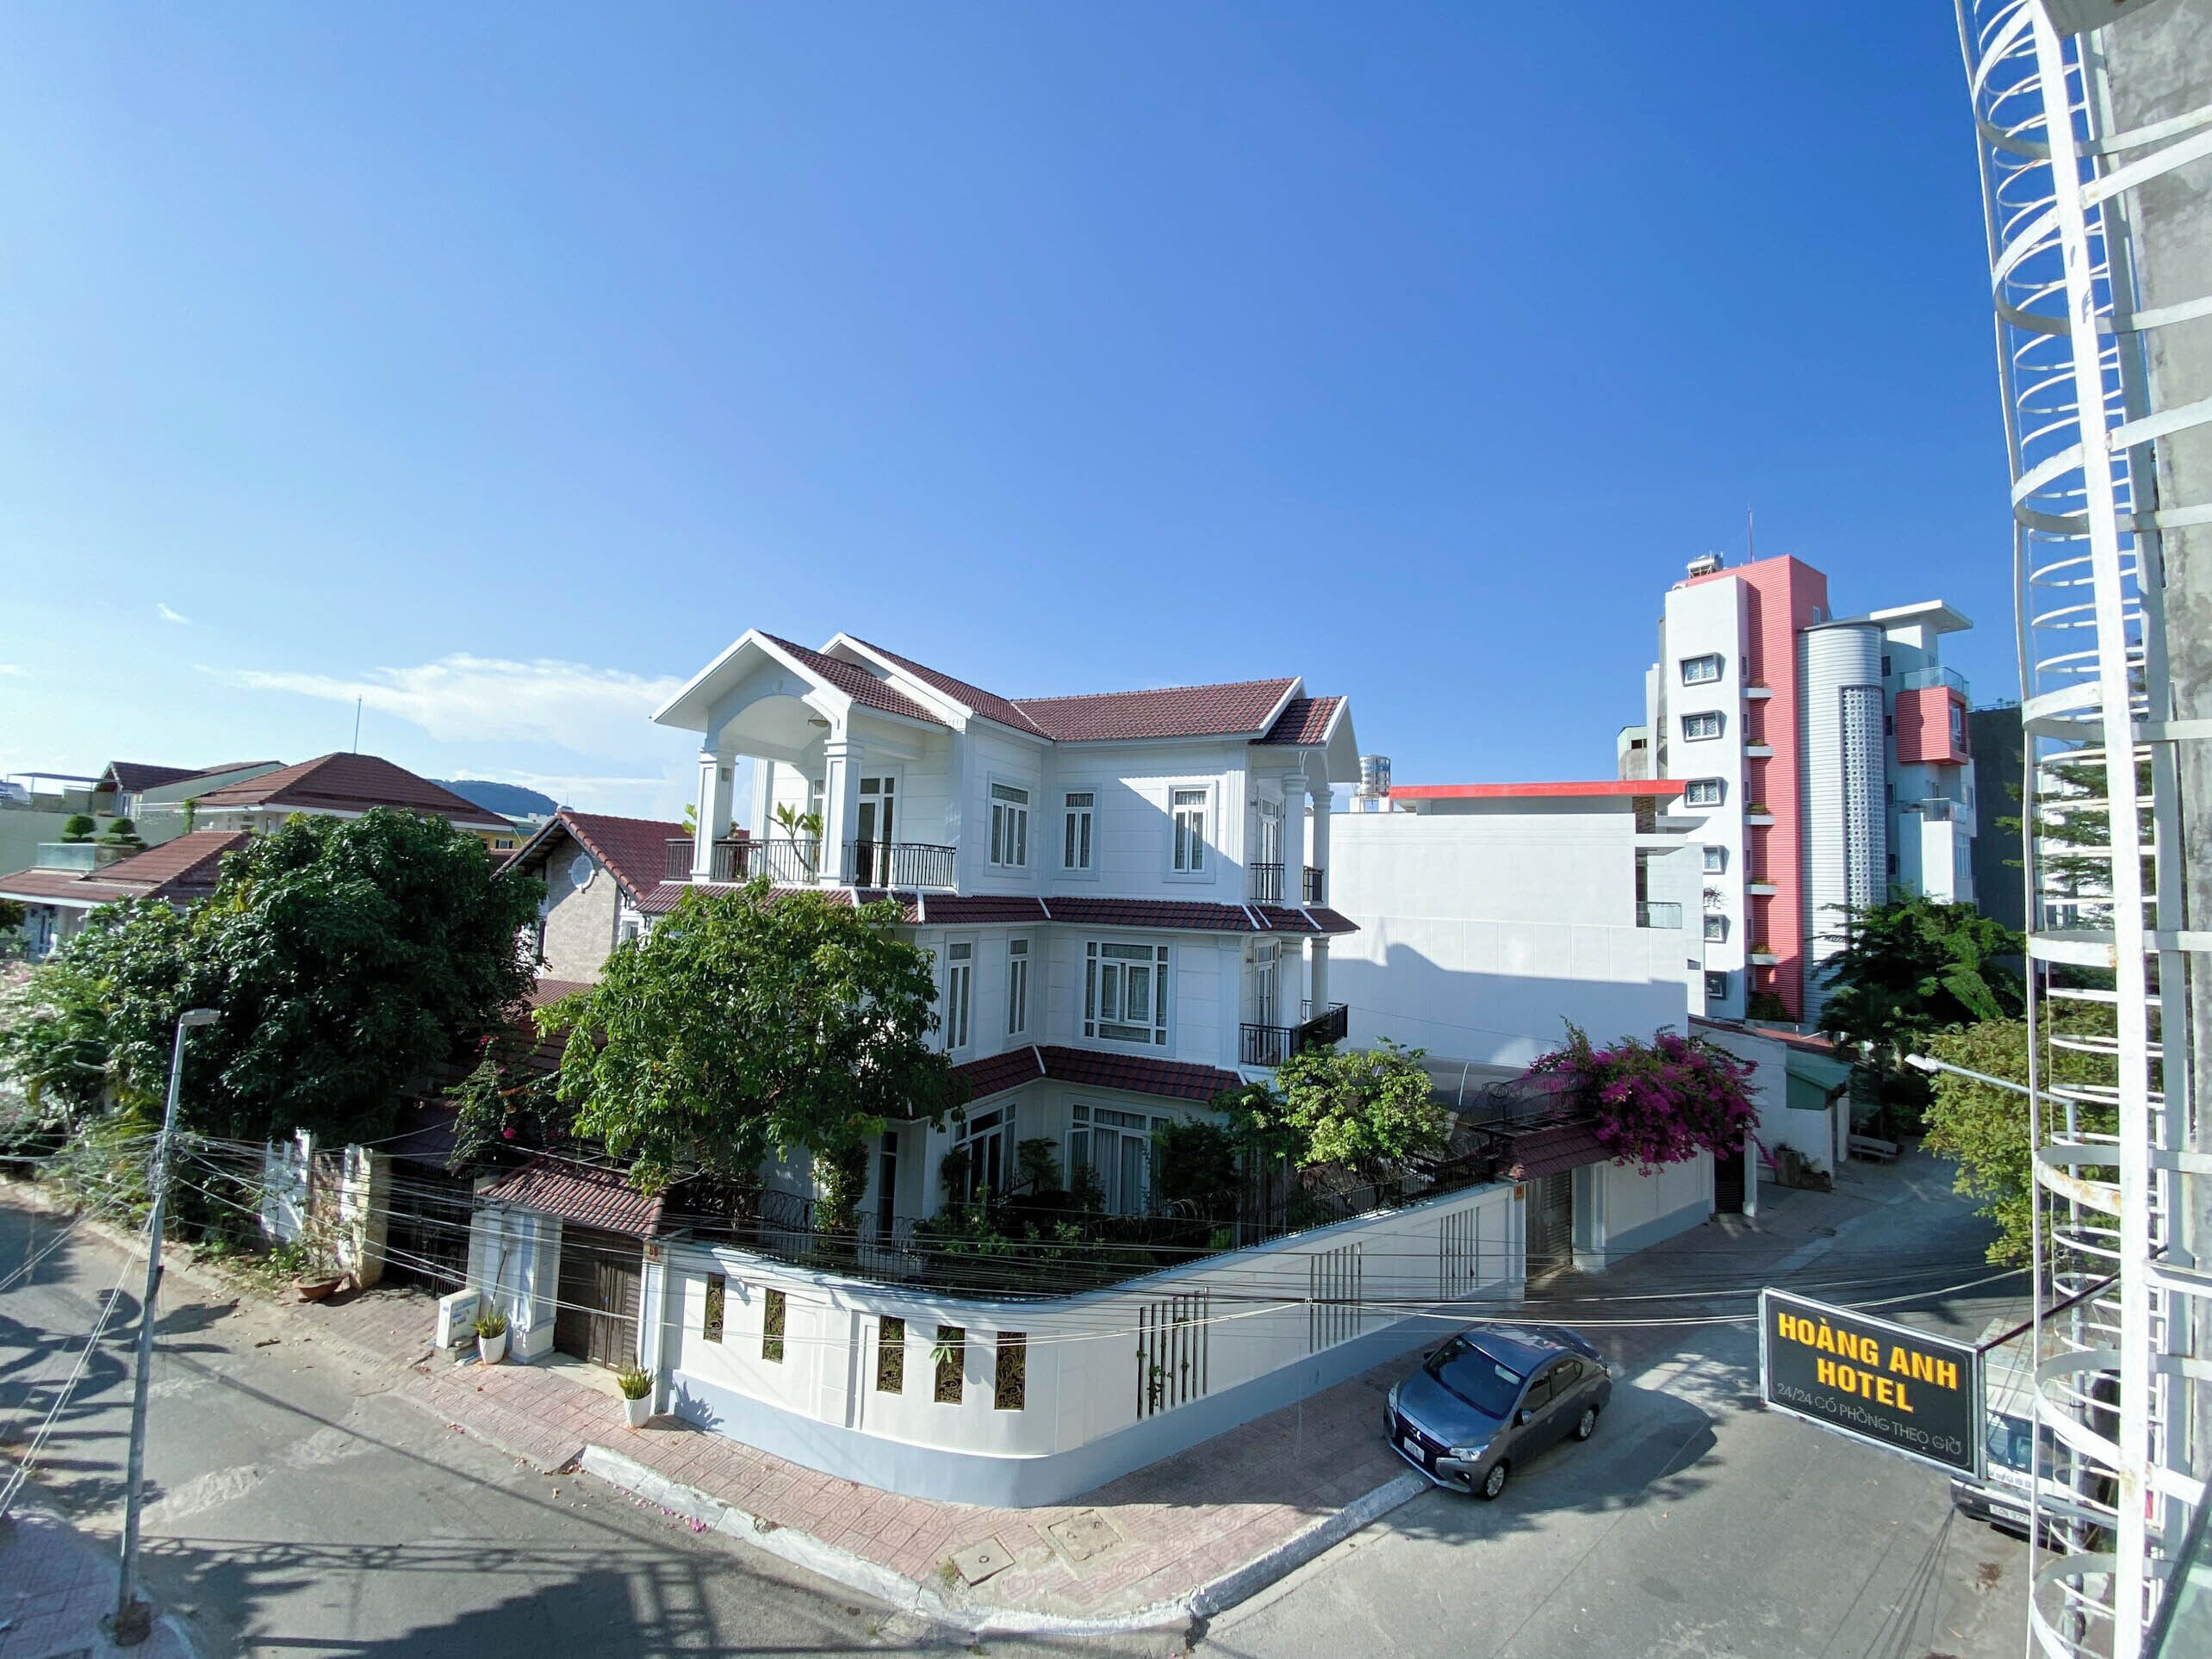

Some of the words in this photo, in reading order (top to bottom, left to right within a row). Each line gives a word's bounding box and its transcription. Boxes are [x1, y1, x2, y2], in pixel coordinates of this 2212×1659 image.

[1778, 1312, 1880, 1367] HOÀNG
[1888, 1345, 1957, 1390] ANH
[1817, 1357, 1914, 1413] HOTEL
[1777, 1382, 1813, 1406] 24/24
[1814, 1395, 1837, 1413] CÓ
[1839, 1403, 1890, 1431] PHÒNG
[1892, 1421, 1929, 1445] THEO
[1931, 1435, 1962, 1455] GIỜ
